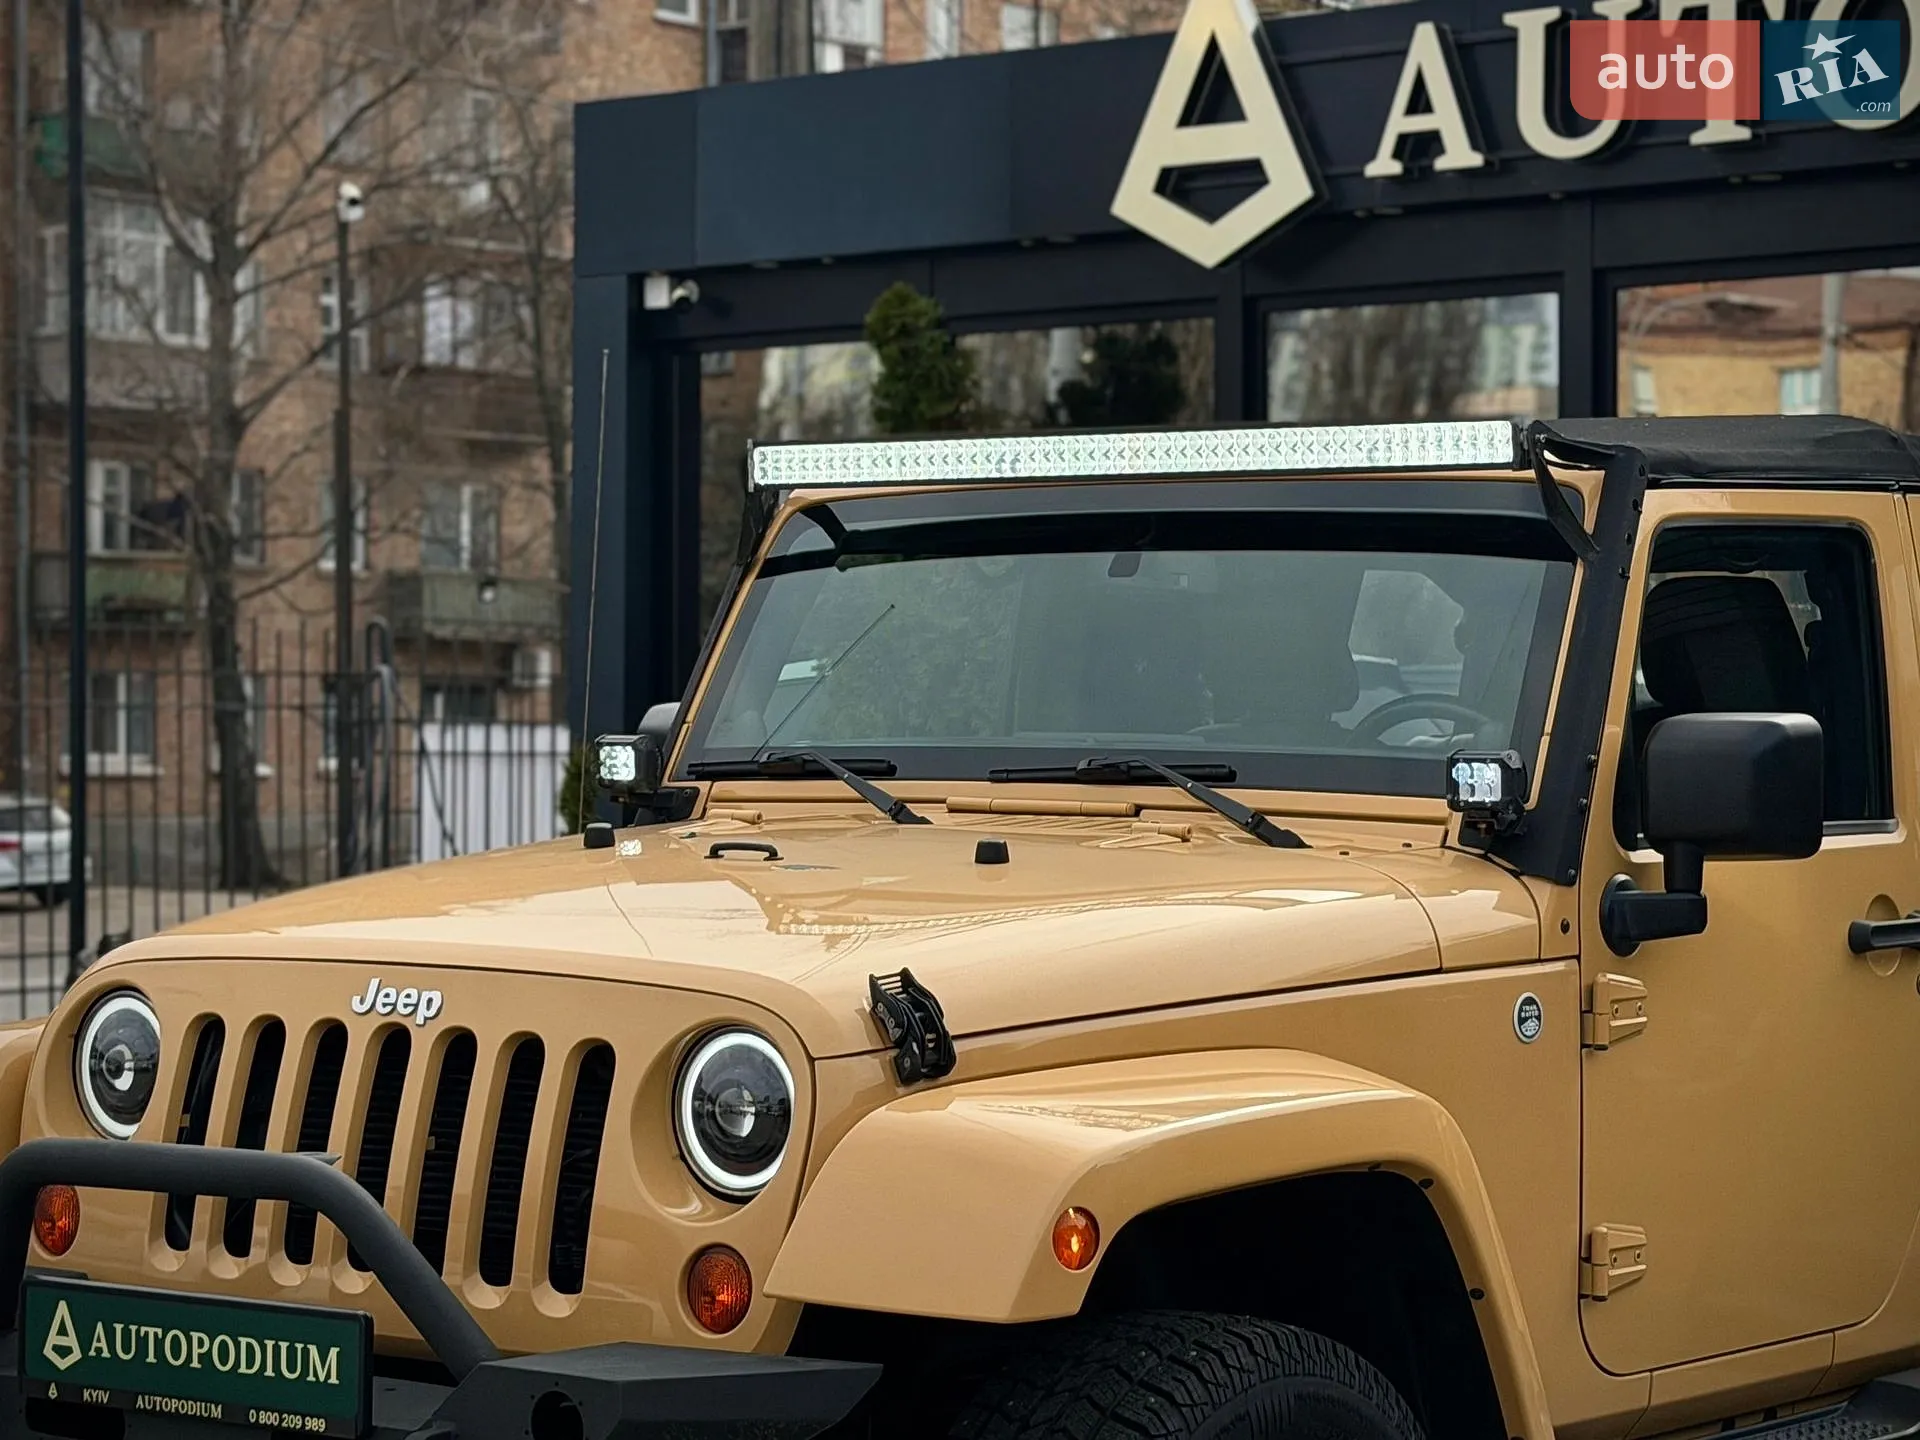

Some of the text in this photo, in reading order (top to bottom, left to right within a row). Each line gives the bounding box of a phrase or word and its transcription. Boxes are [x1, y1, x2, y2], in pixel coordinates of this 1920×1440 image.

[351, 977, 442, 1025] Jeep
[88, 1321, 341, 1385] AUTOPODIUM
[83, 1387, 326, 1433] KYIV AUTOPODIUM 0 800 209 989
